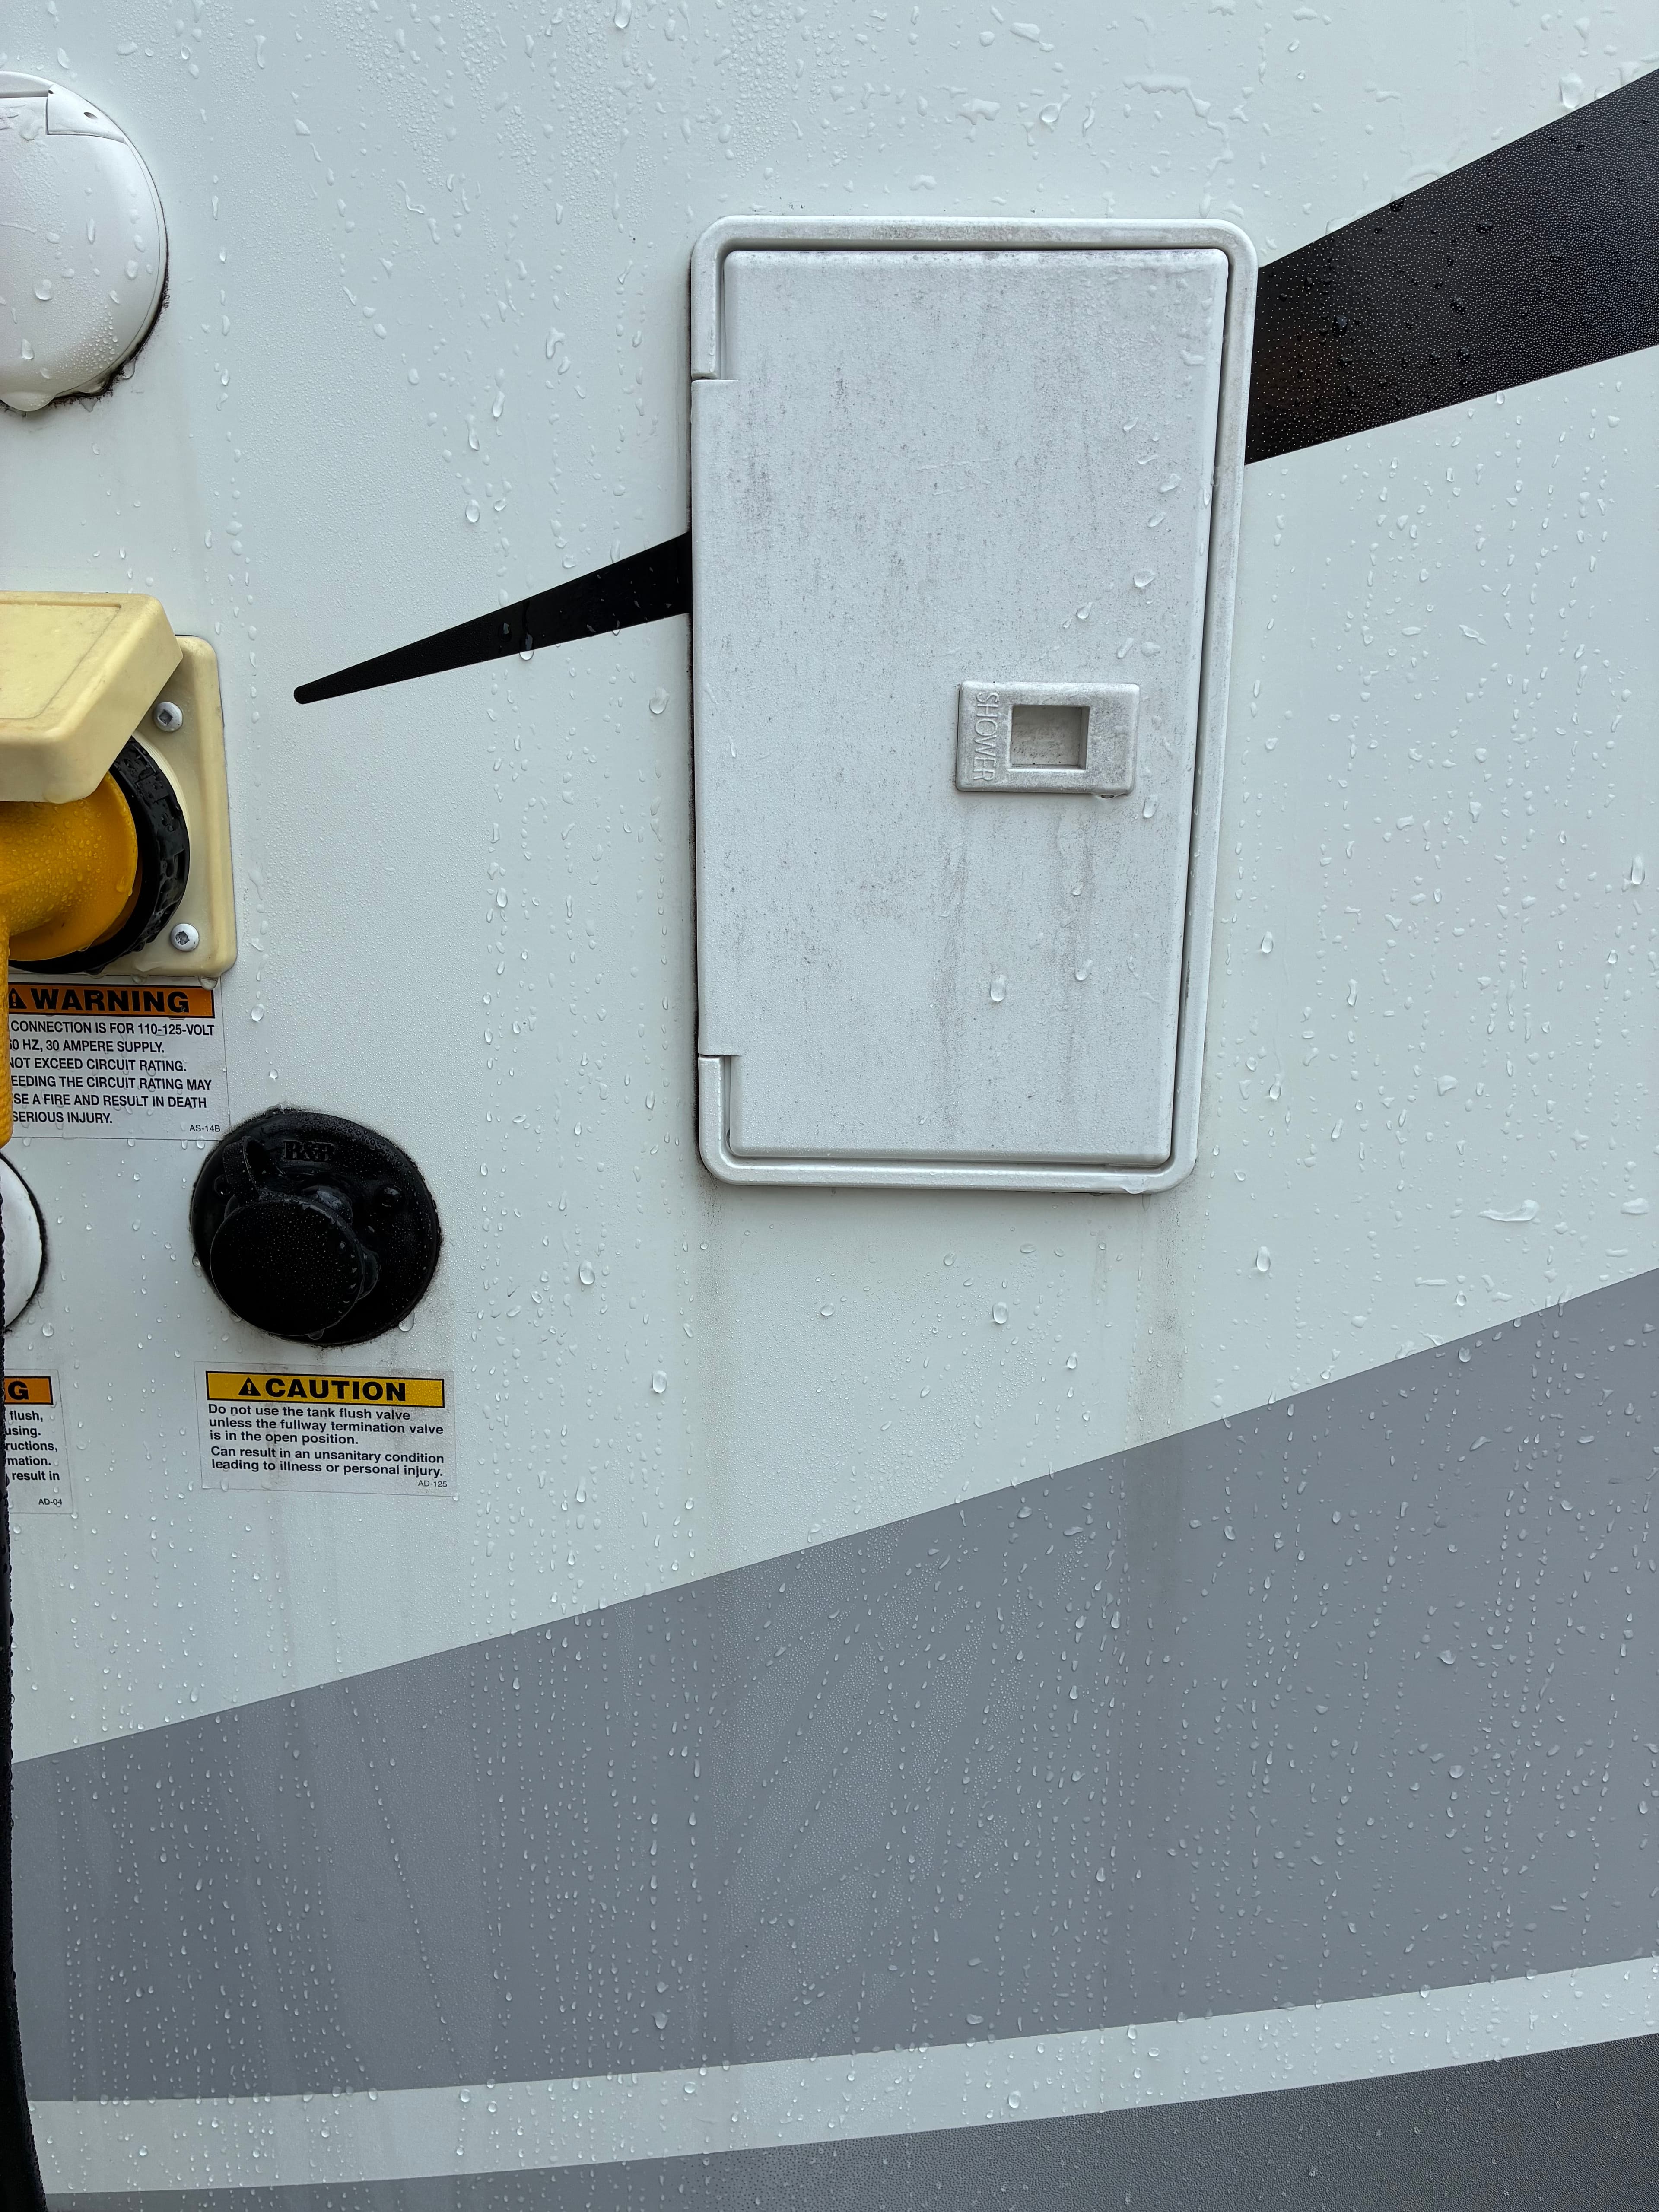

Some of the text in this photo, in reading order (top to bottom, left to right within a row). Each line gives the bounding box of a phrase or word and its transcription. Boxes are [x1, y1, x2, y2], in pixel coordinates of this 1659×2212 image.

[973, 692, 1000, 782] SHOWER
[31, 988, 189, 1012] WARNING
[11, 1020, 214, 1036] CONNECTION IS FOR 110-125-VOLT
[23, 1039, 44, 1052] HZ,
[46, 1040, 59, 1051] 30
[63, 1040, 114, 1052] AMPERE
[117, 1041, 164, 1052] SUPPLY.
[35, 1058, 83, 1069] EXCEED
[87, 1059, 135, 1070] CIRCUIT
[140, 1060, 186, 1071] RATING.
[11, 1076, 211, 1090] EEDING THE CIRCUIT RATING MAY
[14, 1093, 206, 1108] SE A FIRE AND RESULT IN DEATH
[13, 1111, 112, 1123] SERIOUS INJURY.
[266, 1378, 405, 1401] CAUTION
[10, 1411, 42, 1422] flush,
[209, 1404, 226, 1414] Do
[231, 1406, 251, 1414] not
[283, 1407, 303, 1416] the
[307, 1408, 335, 1417] tank
[339, 1408, 371, 1418] flush
[376, 1410, 410, 1420] valve
[210, 1417, 443, 1434] unless the fullway termination valve
[210, 1430, 358, 1445] is in the open position.
[5, 1441, 58, 1452] ructions,
[5, 1456, 51, 1466] mation.
[211, 1446, 235, 1456] Can
[240, 1448, 276, 1457] result
[280, 1448, 290, 1458] in
[315, 1451, 381, 1463] unsanitary
[385, 1453, 443, 1463] condition
[12, 1471, 60, 1480] result in
[212, 1459, 258, 1472] leading
[263, 1461, 275, 1470] to
[280, 1461, 321, 1471] illness
[344, 1465, 399, 1475] personal
[404, 1465, 442, 1478] injury.
